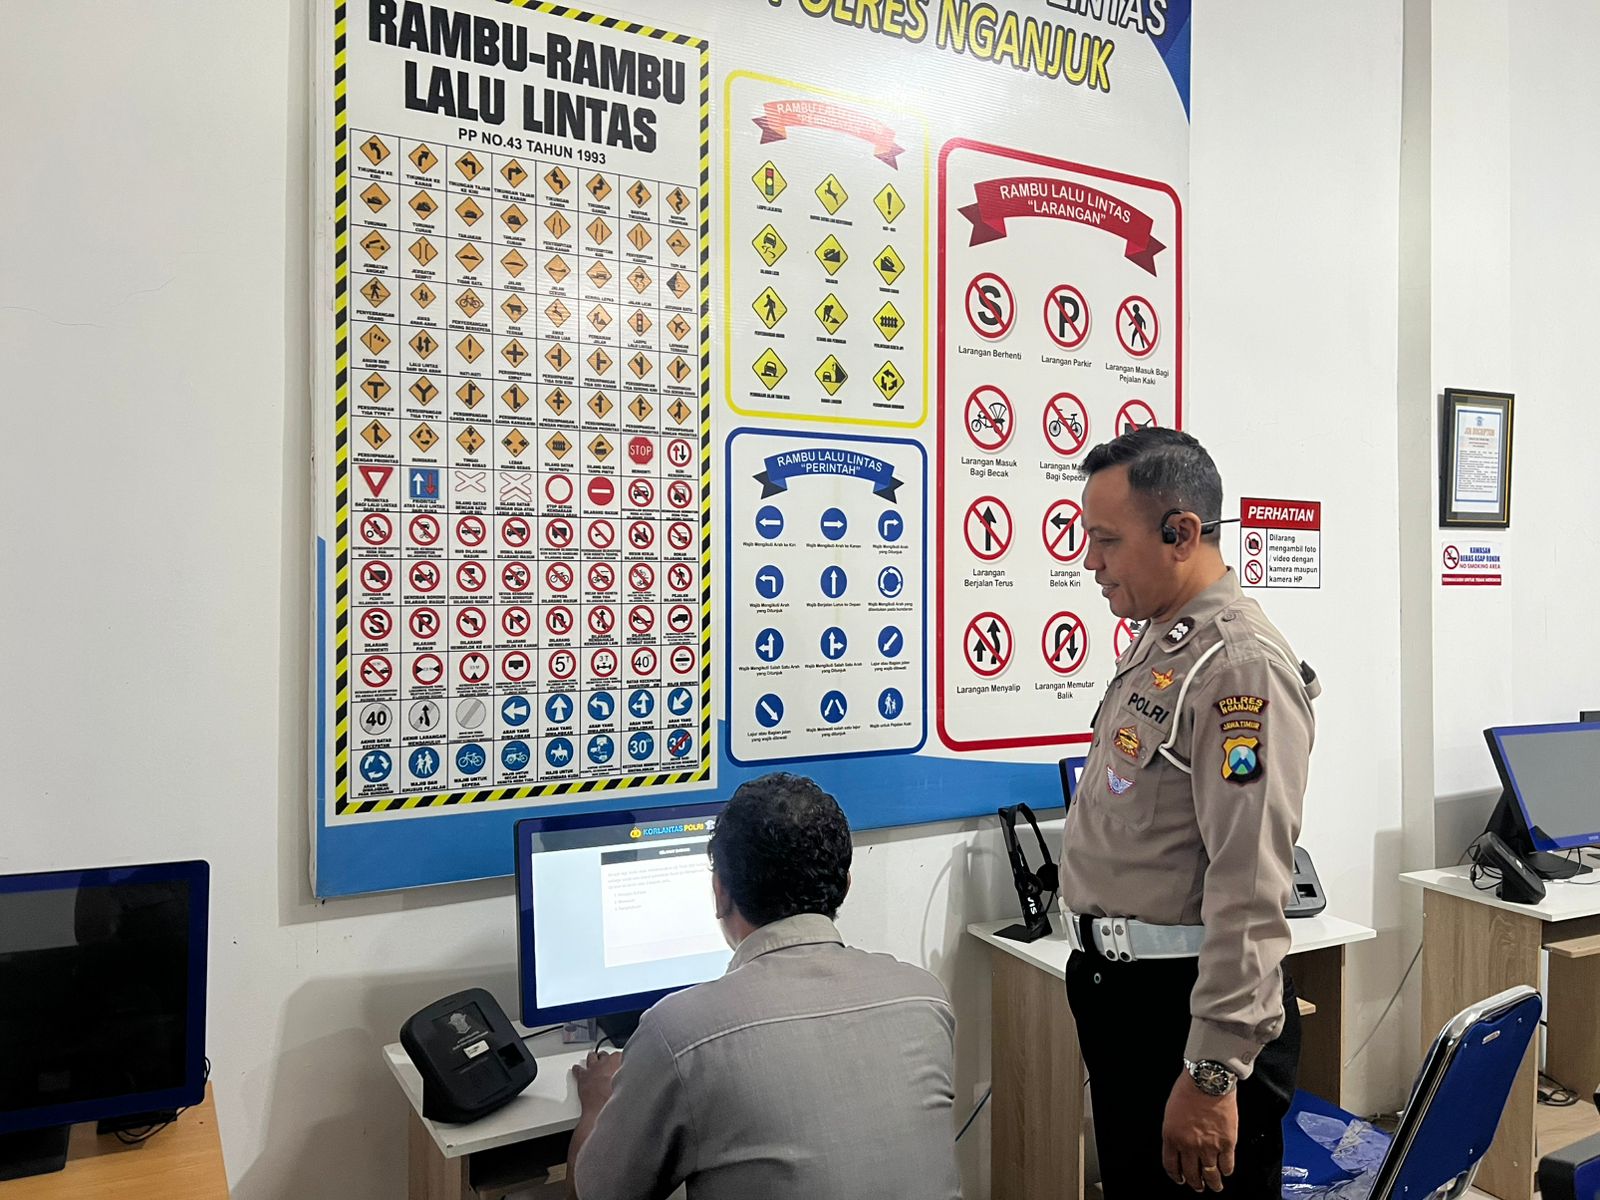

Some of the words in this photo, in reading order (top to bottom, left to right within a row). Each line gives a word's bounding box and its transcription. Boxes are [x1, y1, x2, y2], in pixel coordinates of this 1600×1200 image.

[936, 0, 1115, 92] NGANJUK
[369, 0, 686, 105] RAMBU-RAMBU
[405, 60, 505, 126] LALU
[523, 84, 657, 154] LINTAS
[458, 127, 478, 141] PP
[481, 132, 522, 151] NO.43
[526, 139, 573, 160] TAHUN
[576, 148, 607, 165] 1993
[1000, 184, 1048, 199] RAMBU
[1051, 184, 1084, 203] LALU
[1087, 193, 1131, 223] LINTAS
[958, 345, 991, 358] Larangan
[993, 349, 1022, 361] Berhenti
[1041, 355, 1072, 367] Larangan
[1073, 358, 1092, 368] Parkir
[1105, 362, 1134, 374] Larangan
[1135, 366, 1154, 376] Masuk
[1155, 368, 1169, 378] Bagi
[1119, 374, 1141, 385] Pejalan
[1142, 376, 1156, 386] Kaki
[629, 445, 653, 456] STOP
[777, 451, 816, 468] RAMBU
[818, 451, 844, 462] LALU
[847, 452, 883, 473] LINTAS
[961, 456, 994, 468] Larangan
[995, 458, 1017, 468] Masuk
[1039, 461, 1071, 471] Larangan
[970, 468, 986, 478] Bagi
[987, 469, 1009, 478] Becak
[1045, 472, 1061, 482] Bagi
[1248, 505, 1315, 522] PERHATIAN
[1269, 533, 1296, 543] Dilarang
[1269, 545, 1303, 554] mengambil
[1291, 556, 1314, 564] dengan
[973, 568, 1005, 579] Larangan
[1050, 569, 1081, 579] Larangan
[1293, 567, 1317, 575] maupun
[964, 578, 993, 589] Berjalan
[994, 578, 1014, 588] Terus
[1049, 578, 1068, 588] Belok
[1069, 578, 1081, 587] Kiri
[555, 656, 566, 672] 5
[634, 656, 649, 669] 40
[957, 685, 990, 696] Larangan
[991, 684, 1021, 695] Menyalip
[1035, 682, 1066, 693] Larangan
[1066, 680, 1095, 690] Memutar
[1057, 691, 1074, 700] Balik
[1219, 696, 1263, 707] POLRES
[1127, 692, 1170, 725] POLRI
[1222, 703, 1260, 714] NGANJUK
[366, 710, 387, 727] 40
[630, 739, 647, 754] 30
